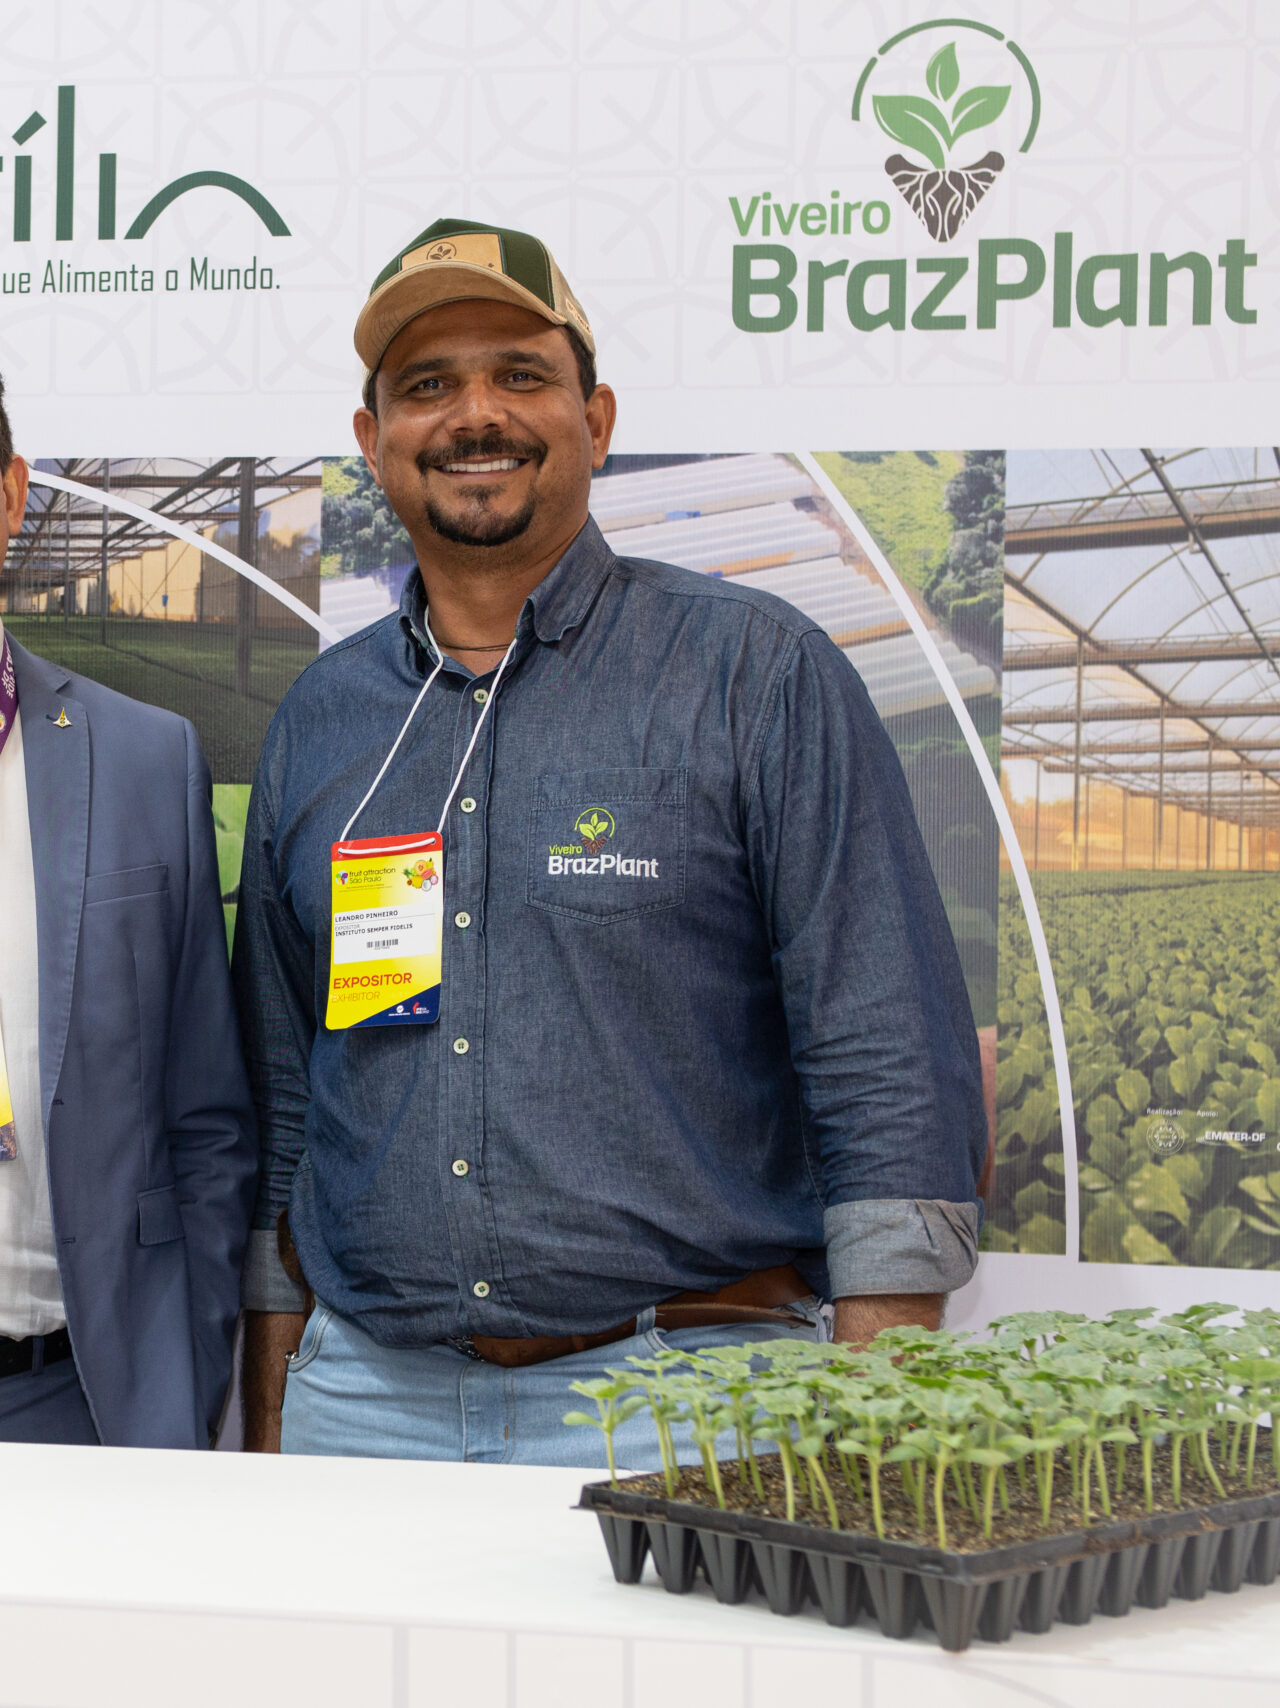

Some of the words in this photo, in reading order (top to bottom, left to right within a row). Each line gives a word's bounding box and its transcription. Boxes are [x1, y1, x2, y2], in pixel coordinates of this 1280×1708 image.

[728, 190, 891, 236] Viveiro
[41, 260, 155, 293] Alimenta
[165, 268, 178, 292] o
[190, 256, 281, 291] Mundo.
[731, 232, 1258, 333] BrazPlant
[548, 843, 583, 855] Viveiro
[548, 853, 659, 878] BrazPlant
[334, 914, 365, 923] LEANDRO
[365, 910, 399, 919] PINHEIRO
[335, 929, 366, 937] INSTITUTO
[366, 925, 389, 934] SEMPER
[389, 923, 413, 931] FIDELIS
[333, 972, 413, 990] EXPOSITOR
[331, 991, 381, 1004] EXHIBITOR
[1204, 1130, 1266, 1142] EMATER-DF
